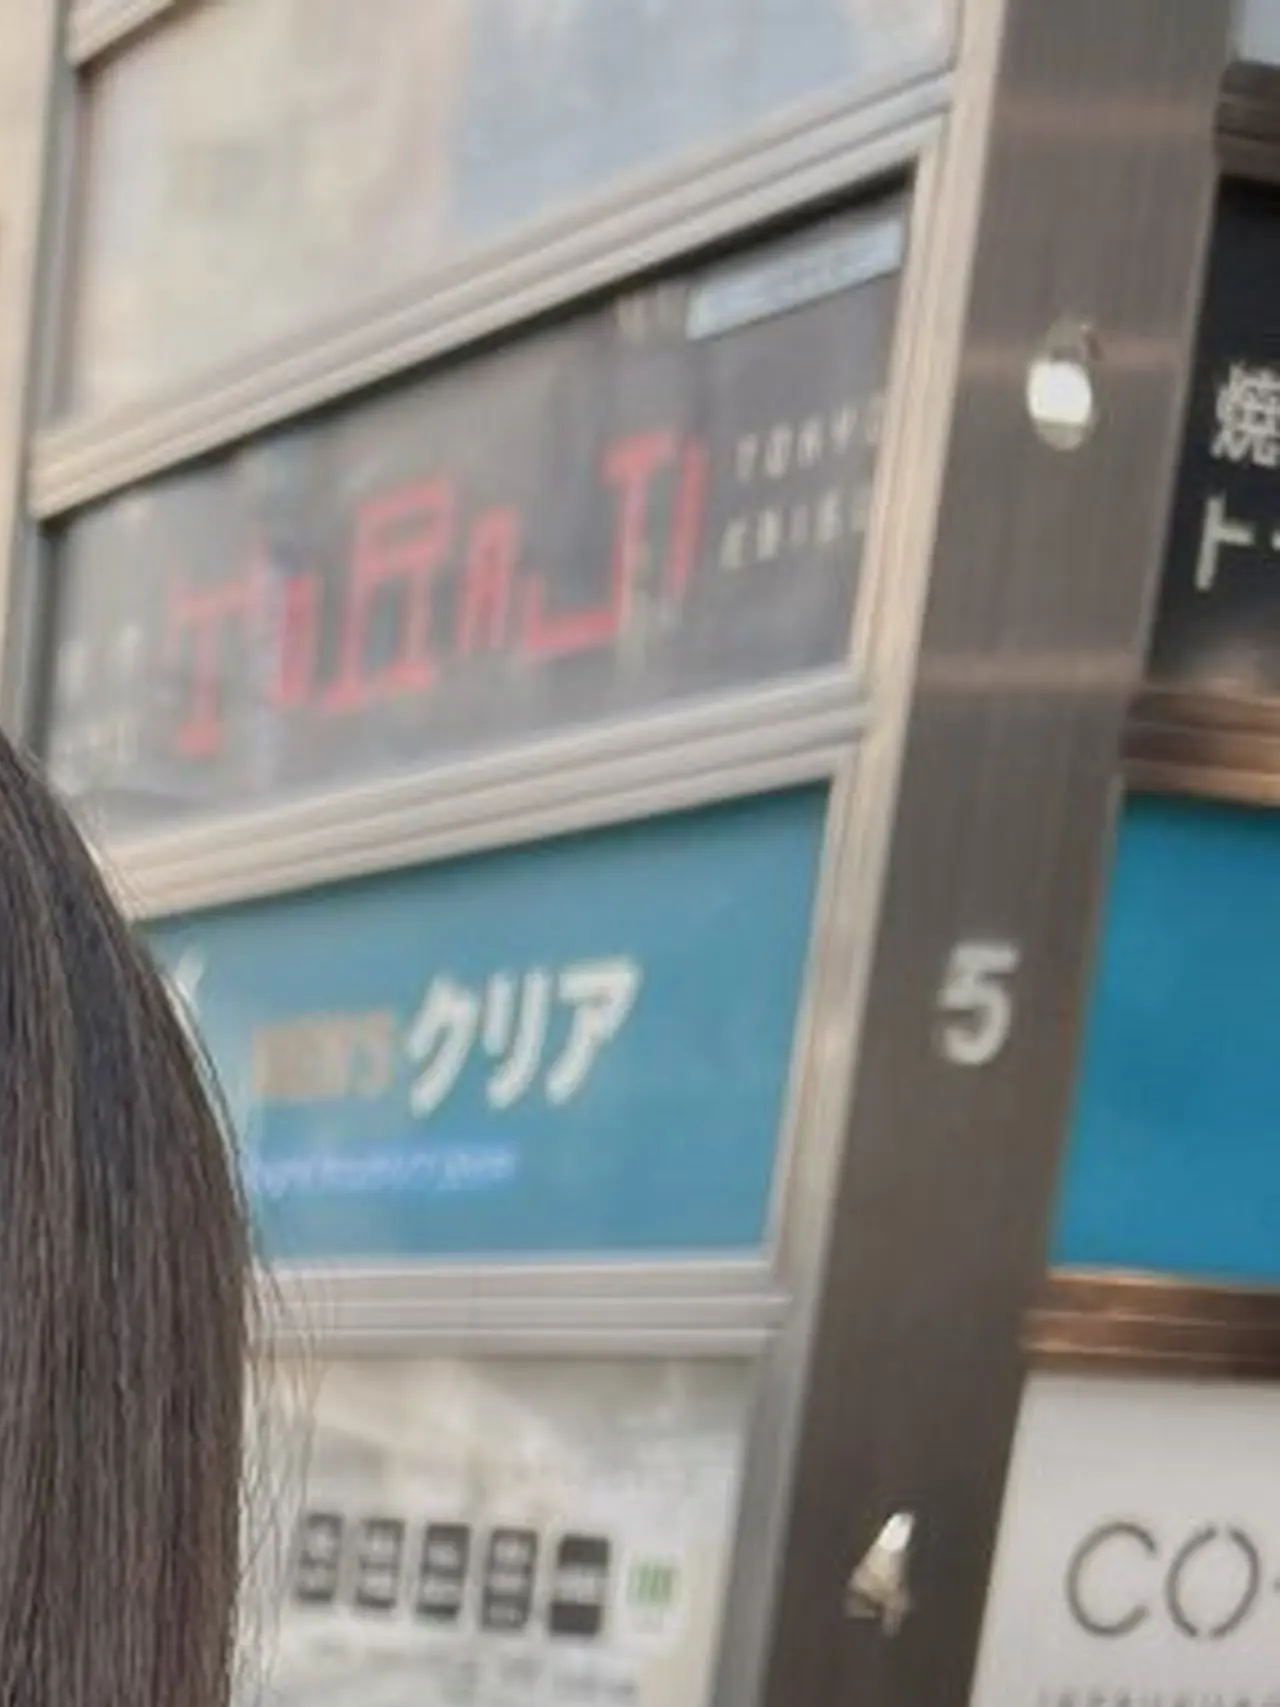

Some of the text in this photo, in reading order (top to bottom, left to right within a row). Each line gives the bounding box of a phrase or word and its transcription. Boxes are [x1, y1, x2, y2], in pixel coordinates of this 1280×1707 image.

[404, 952, 640, 1118] クリア
[936, 938, 1020, 1066] 5
[846, 1512, 915, 1636] 4
